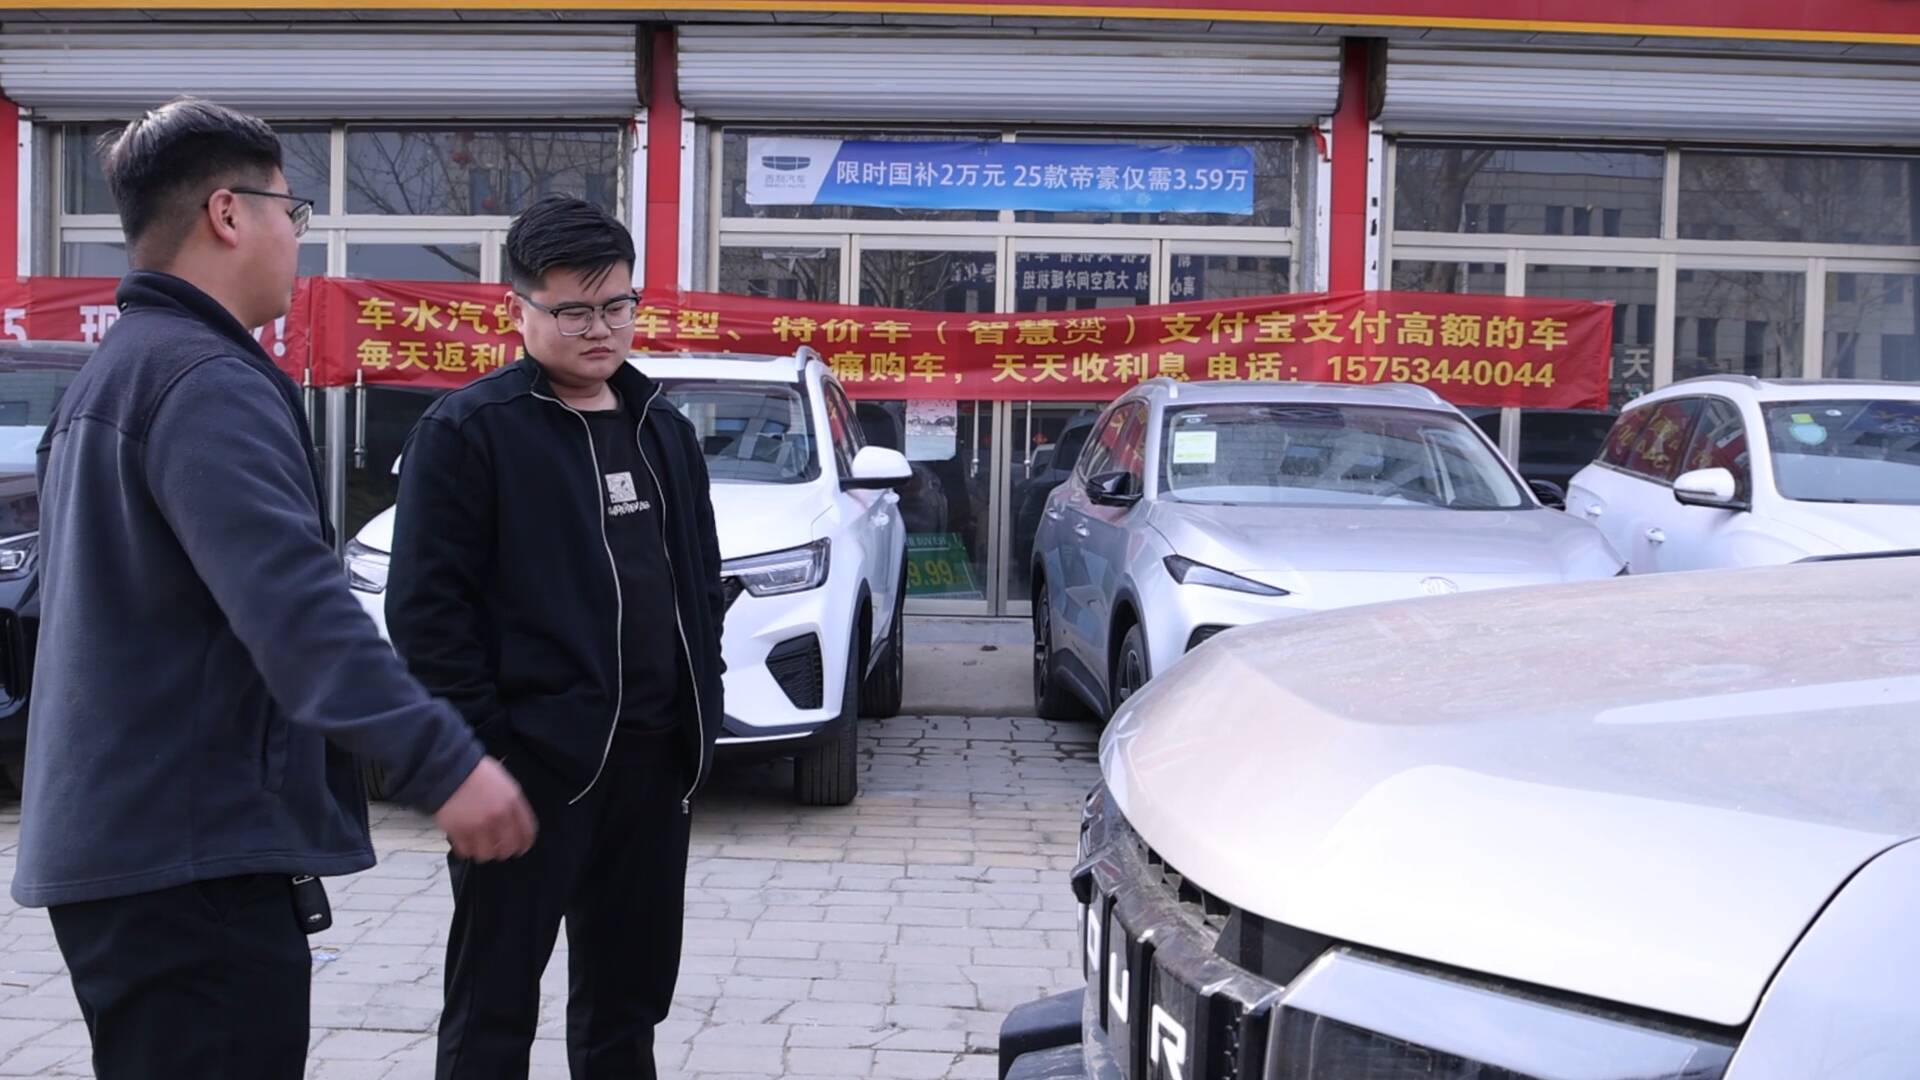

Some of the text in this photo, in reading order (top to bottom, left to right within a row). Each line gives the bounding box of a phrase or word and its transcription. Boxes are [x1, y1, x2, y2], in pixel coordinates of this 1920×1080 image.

[836, 160, 1249, 192] 限时国补2万元 25款帝豪仅需3.59万
[356, 338, 525, 374] 每天返利
[1079, 903, 1187, 1080] OUR
